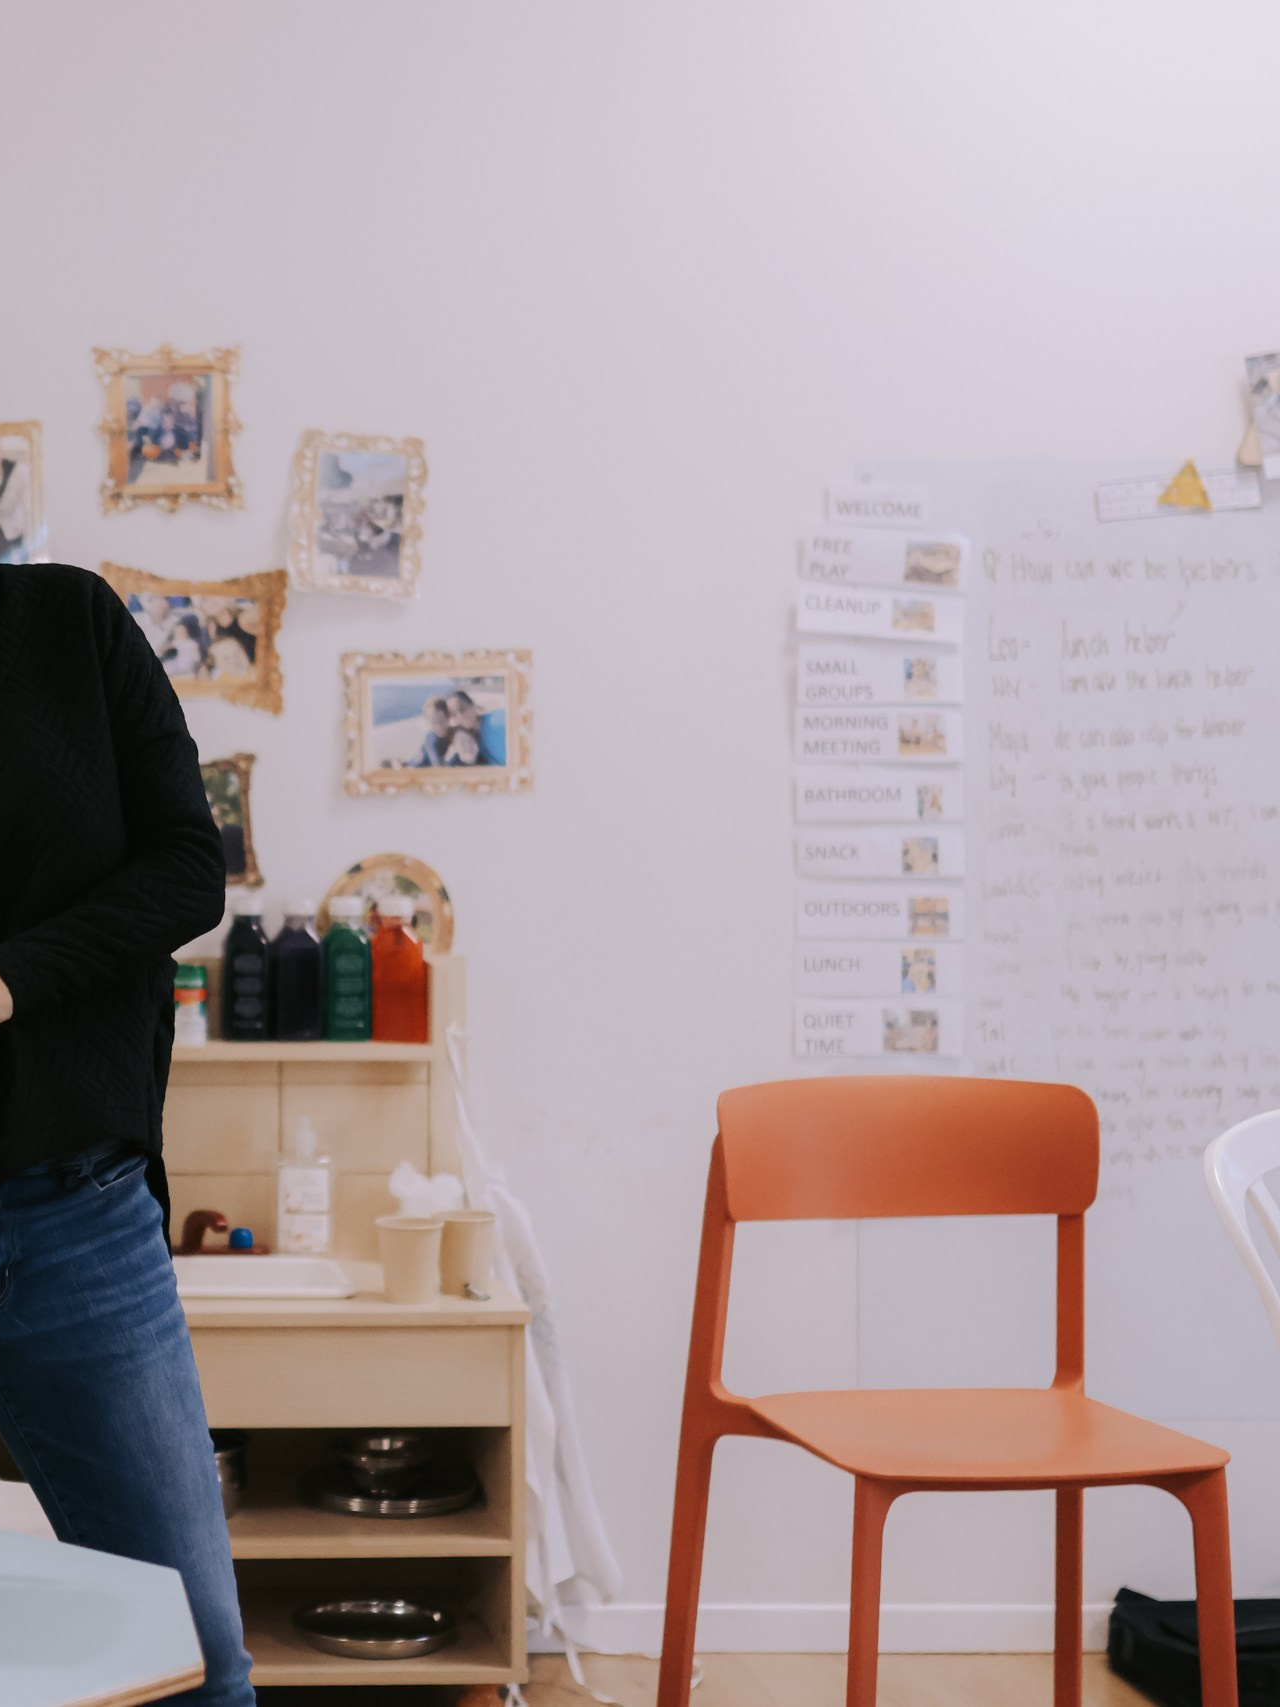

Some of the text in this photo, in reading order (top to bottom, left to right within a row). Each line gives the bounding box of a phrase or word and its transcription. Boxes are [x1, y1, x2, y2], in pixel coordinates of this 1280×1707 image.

[835, 500, 922, 519] WELCOME
[812, 537, 852, 556] FREE
[809, 563, 850, 580] PLAY
[804, 595, 881, 615] CLEANUP
[806, 660, 858, 676] SMALL
[805, 685, 873, 701] GROUPS
[803, 716, 888, 731] MORNING
[803, 740, 881, 755] MEETING
[804, 788, 902, 803] BATHROOM
[804, 846, 860, 861] SNACK
[804, 902, 900, 917] OUTDOORS
[803, 958, 860, 973] LUNCH
[803, 1014, 854, 1030] QUIET
[803, 1039, 844, 1054] TIME
